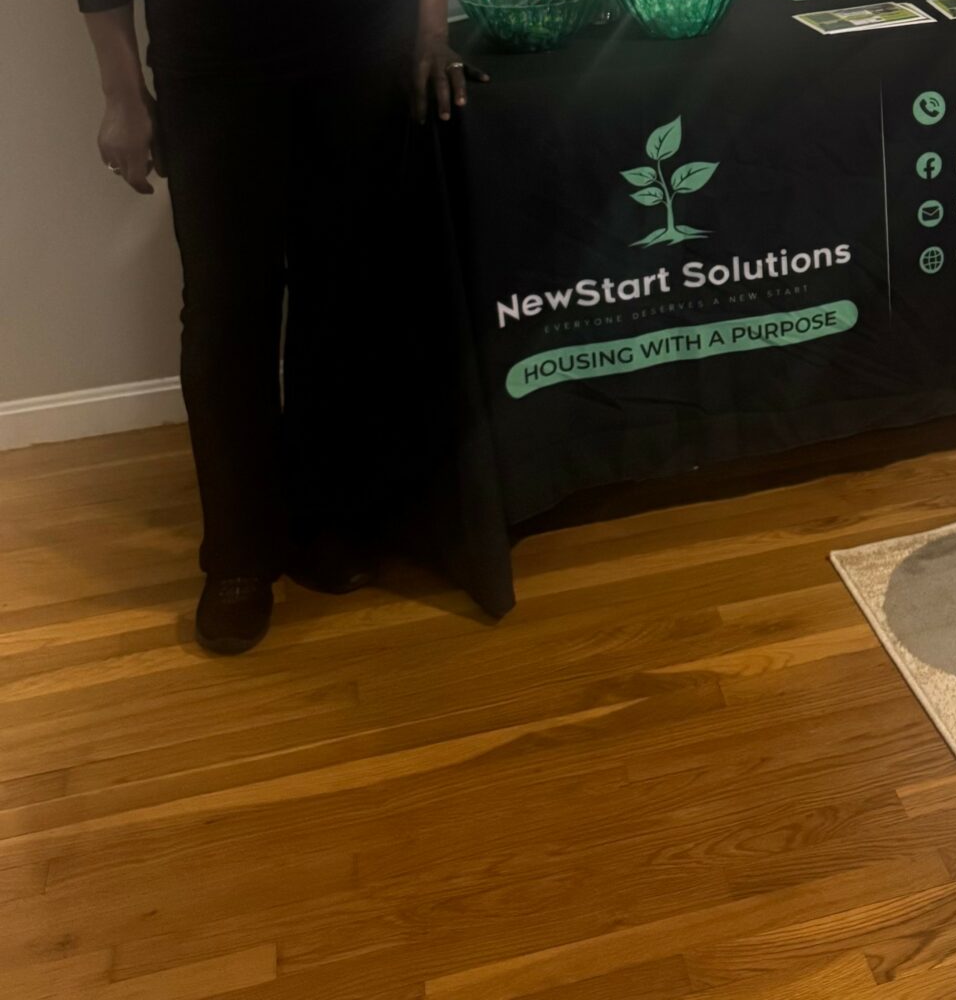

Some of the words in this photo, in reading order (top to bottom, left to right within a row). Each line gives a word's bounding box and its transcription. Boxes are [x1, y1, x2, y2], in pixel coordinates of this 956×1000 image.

[496, 266, 670, 329] NewStart
[682, 243, 852, 288] Solutions
[544, 315, 623, 334] EVERYONE
[632, 300, 703, 320] DESERVES
[713, 297, 720, 305] A
[729, 292, 758, 304] NEW
[767, 284, 808, 298] START
[524, 347, 634, 384] HOUSING
[640, 334, 701, 360] WITH
[708, 330, 724, 348] A
[731, 310, 838, 344] PURPOSE
